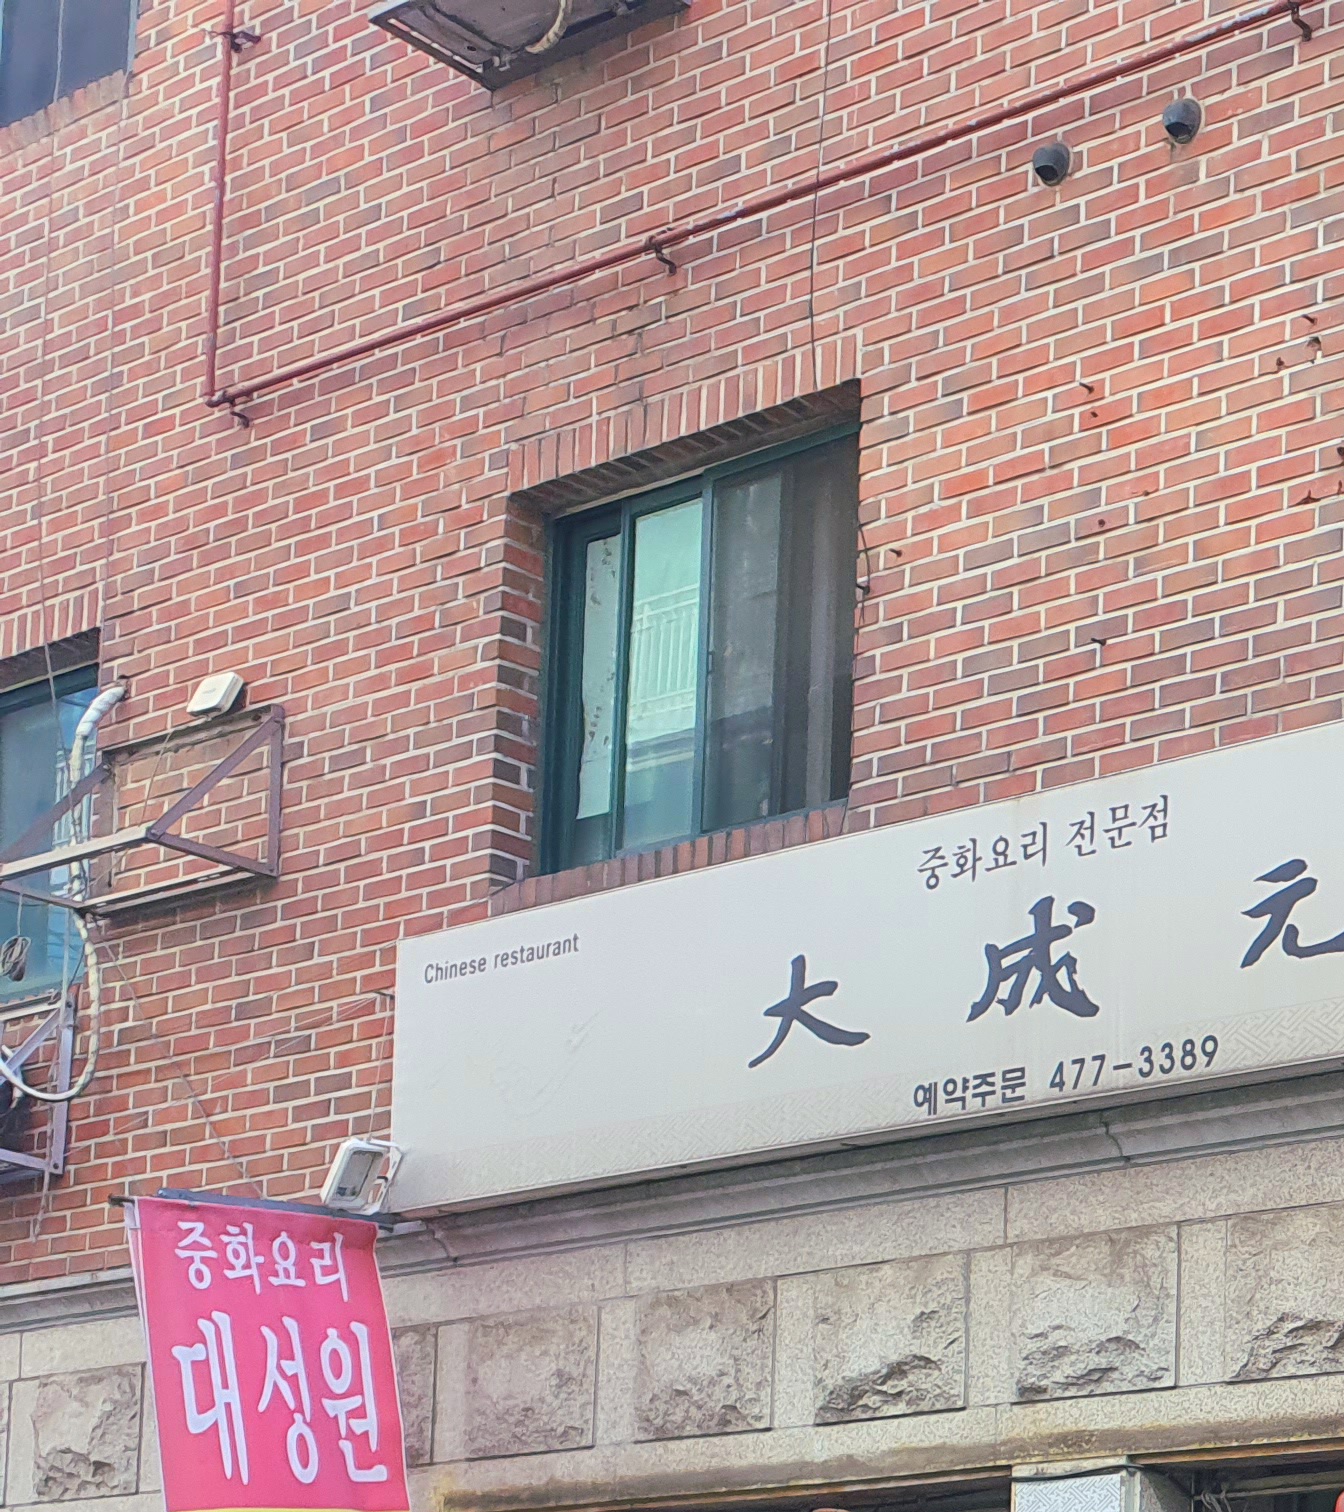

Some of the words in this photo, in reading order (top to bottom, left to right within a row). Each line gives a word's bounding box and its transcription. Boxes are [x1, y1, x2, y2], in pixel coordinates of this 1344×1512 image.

[916, 821, 1050, 891] 중화요리
[1065, 794, 1171, 859] 전문점
[423, 953, 488, 985] Chinese
[492, 931, 581, 970] restaurant
[912, 1064, 1028, 1117] 예약주문
[1048, 1033, 1219, 1094] 477-3389
[175, 1221, 350, 1302] 중화요리
[171, 1310, 388, 1486] 대성원
